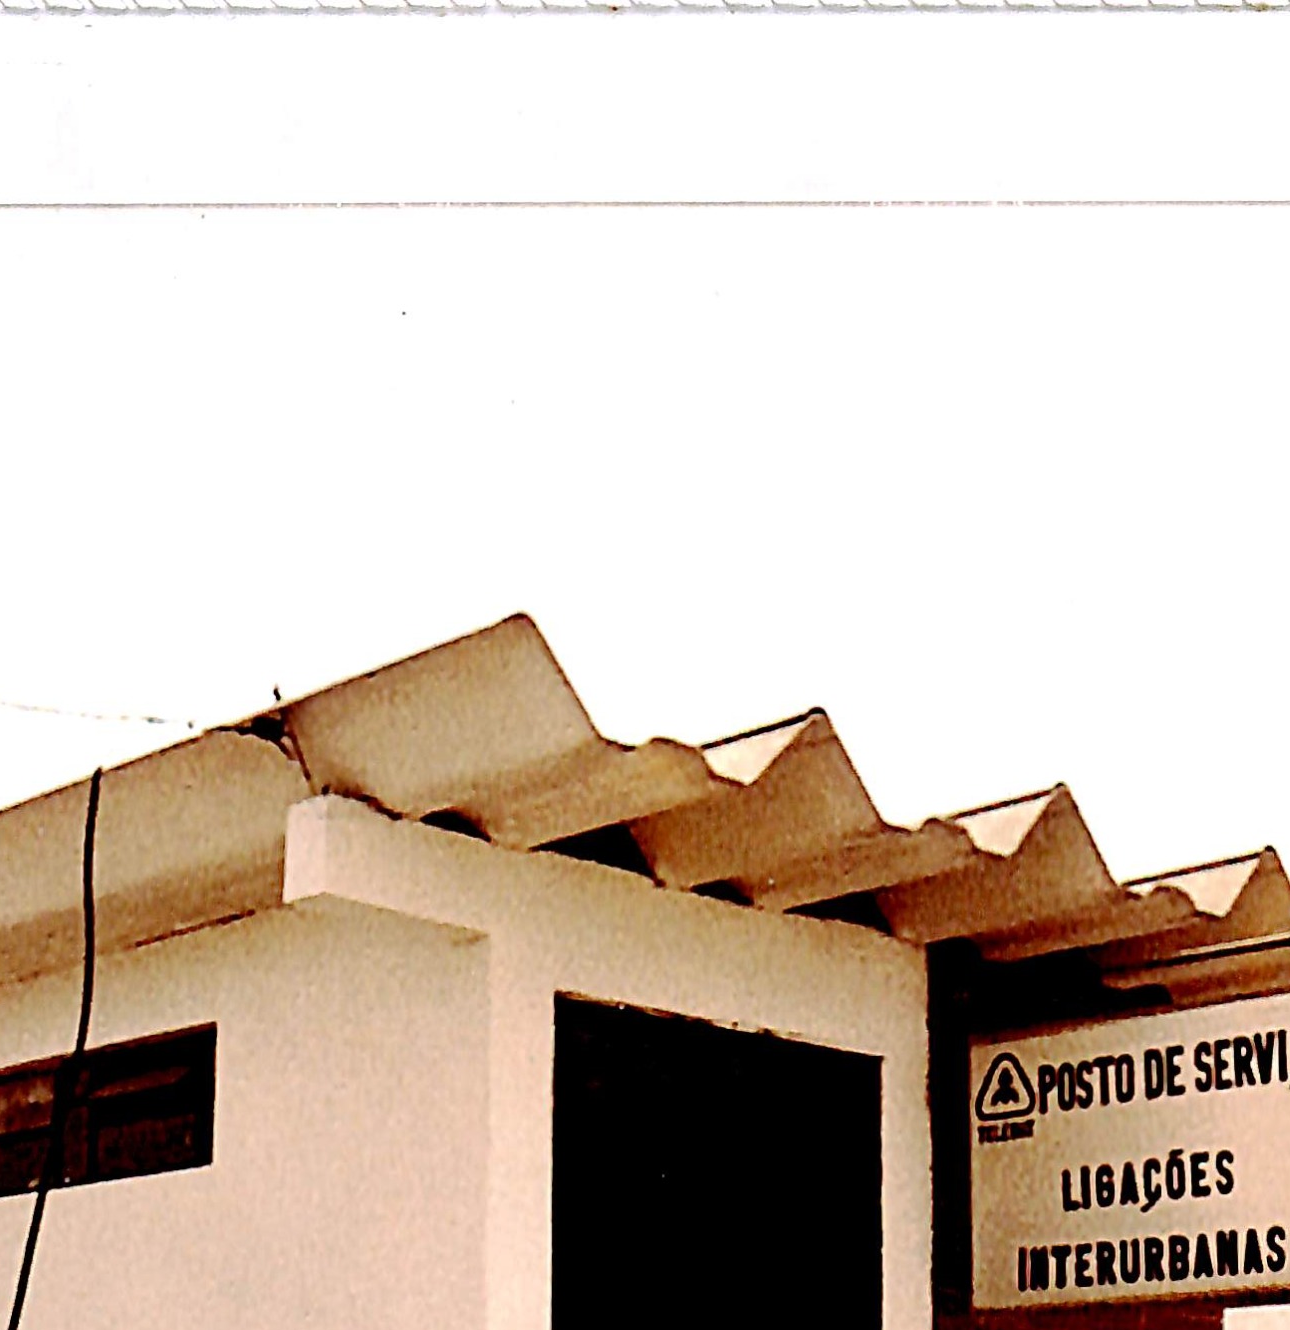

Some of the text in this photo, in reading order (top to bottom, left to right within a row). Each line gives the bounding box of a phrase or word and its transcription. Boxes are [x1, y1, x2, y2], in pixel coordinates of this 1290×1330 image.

[1037, 1053, 1135, 1115] POSTO
[1143, 1045, 1187, 1101] DE
[1017, 1225, 1287, 1292] INTERURBANAS
